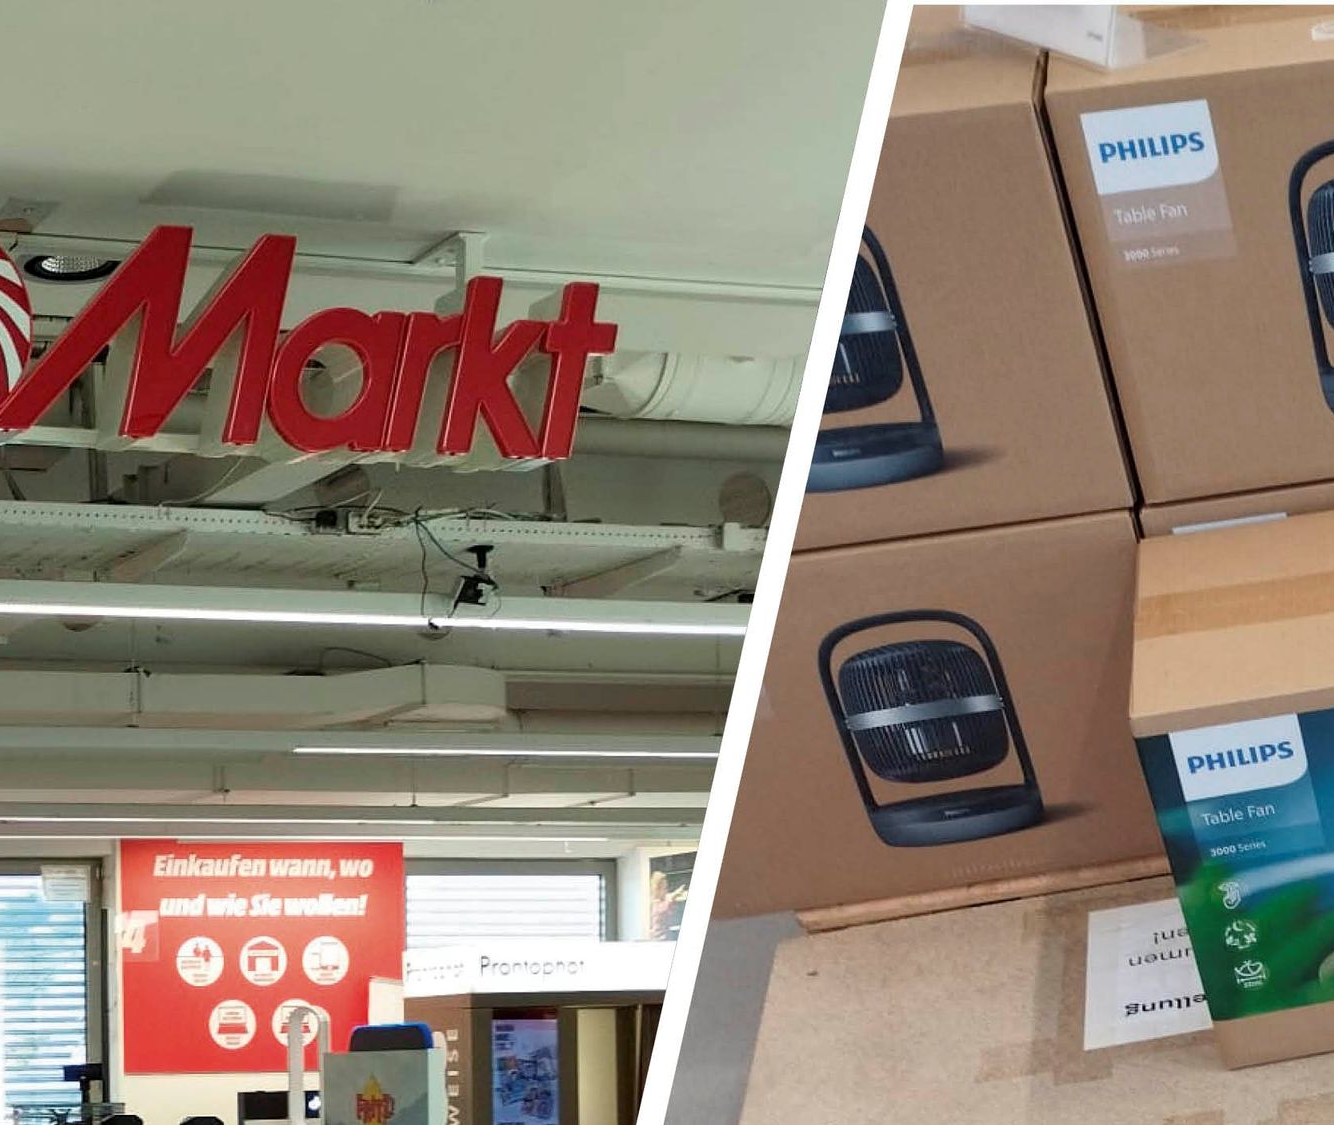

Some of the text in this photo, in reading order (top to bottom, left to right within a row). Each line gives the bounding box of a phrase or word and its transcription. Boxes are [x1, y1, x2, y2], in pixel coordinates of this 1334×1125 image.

[1099, 132, 1205, 163] PHILIPS
[1114, 203, 1188, 225] Table Fan
[1187, 741, 1294, 774] PHILIPS
[1202, 804, 1275, 826] Table Fan
[1238, 841, 1266, 852] Series
[153, 854, 374, 879] Einkaufen wann, wo
[159, 893, 368, 917] und wie Sie wollen!
[480, 955, 586, 976] Prontophot
[1125, 993, 1207, 1017] ellung
